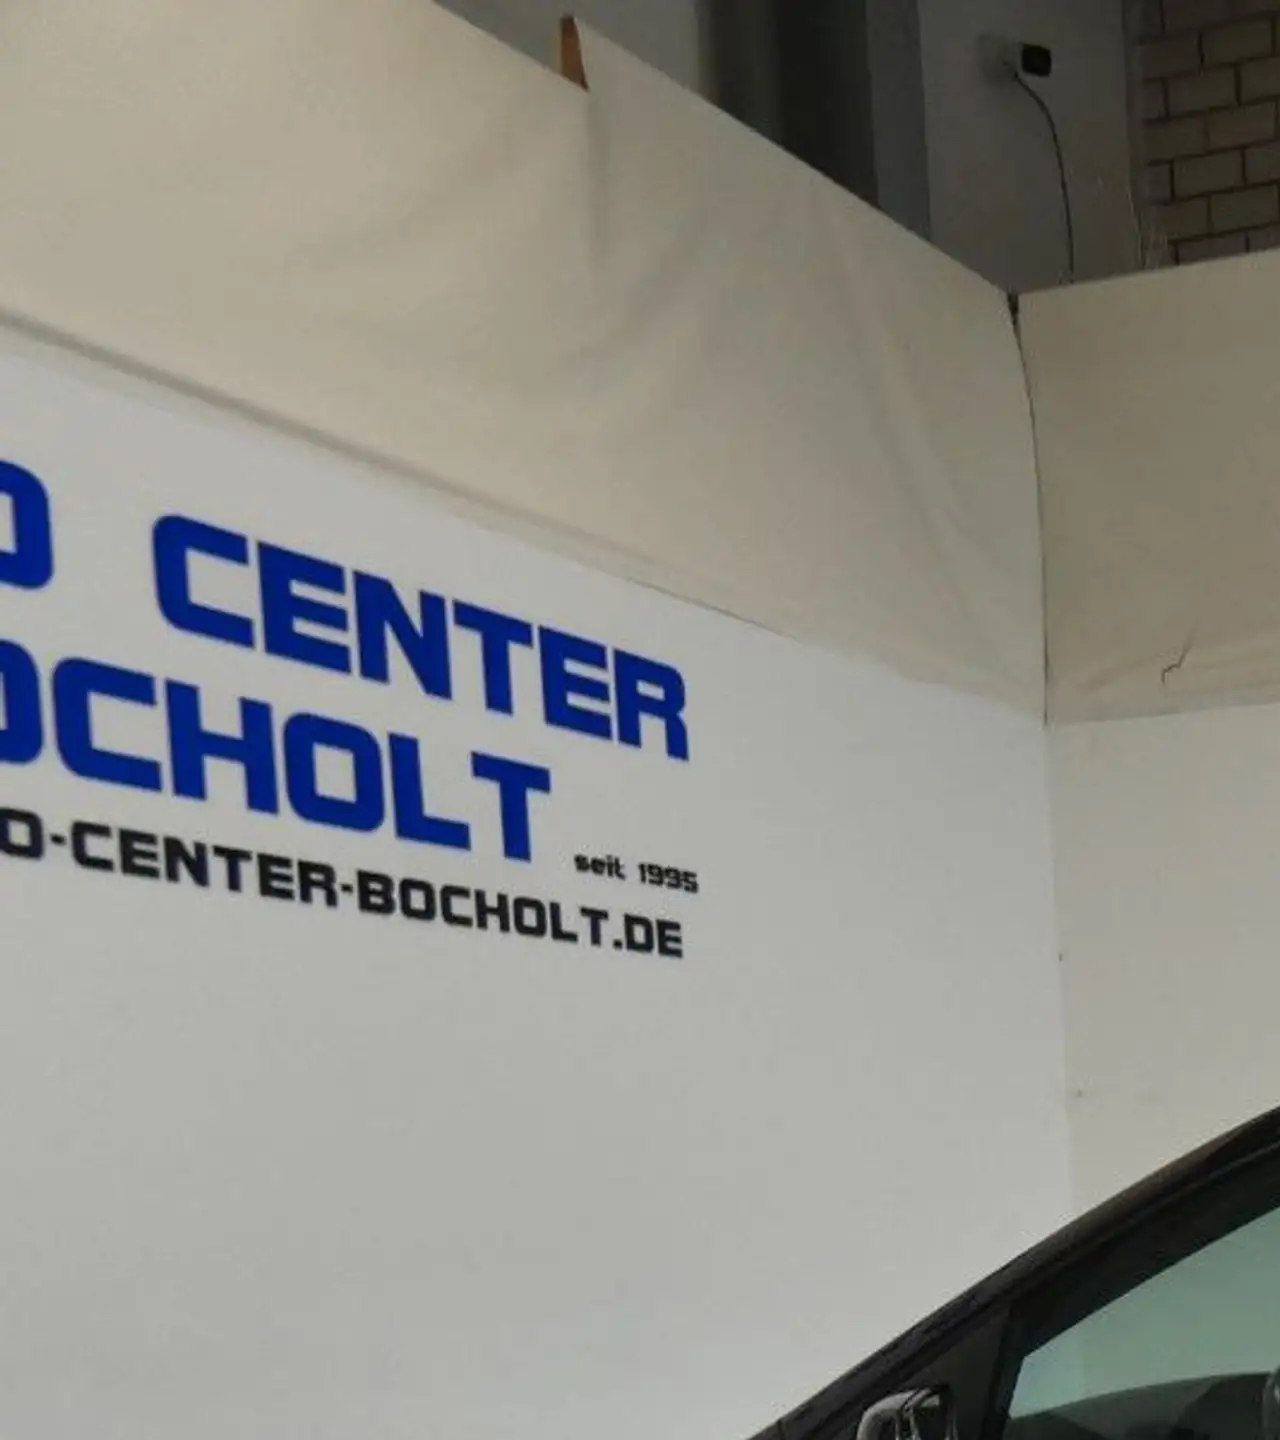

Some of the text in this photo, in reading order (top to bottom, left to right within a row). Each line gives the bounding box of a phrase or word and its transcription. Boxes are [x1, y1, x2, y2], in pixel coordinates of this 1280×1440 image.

[152, 514, 689, 762] CENTER
[573, 854, 699, 894] seit 1995
